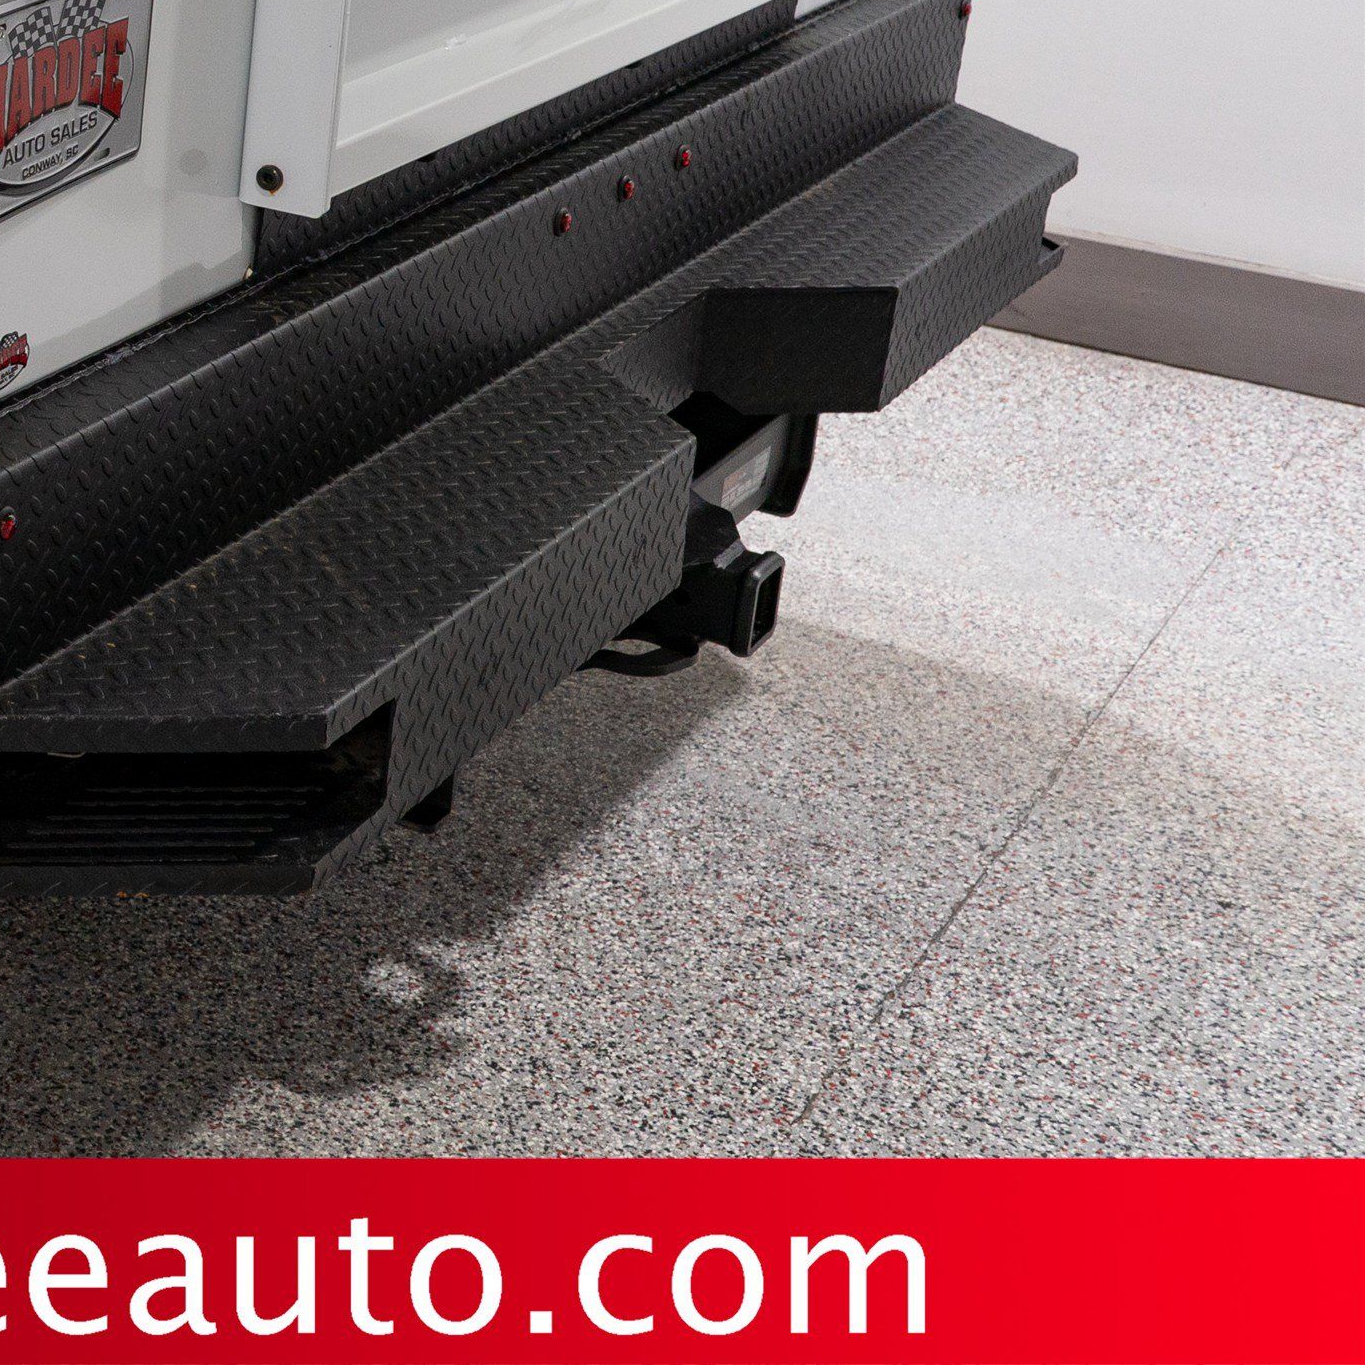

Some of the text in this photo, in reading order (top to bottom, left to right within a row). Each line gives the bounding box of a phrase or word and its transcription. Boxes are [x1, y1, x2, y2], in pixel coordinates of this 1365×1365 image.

[3, 110, 98, 168] AUTO SALES
[22, 144, 79, 180] CONWAY, SC
